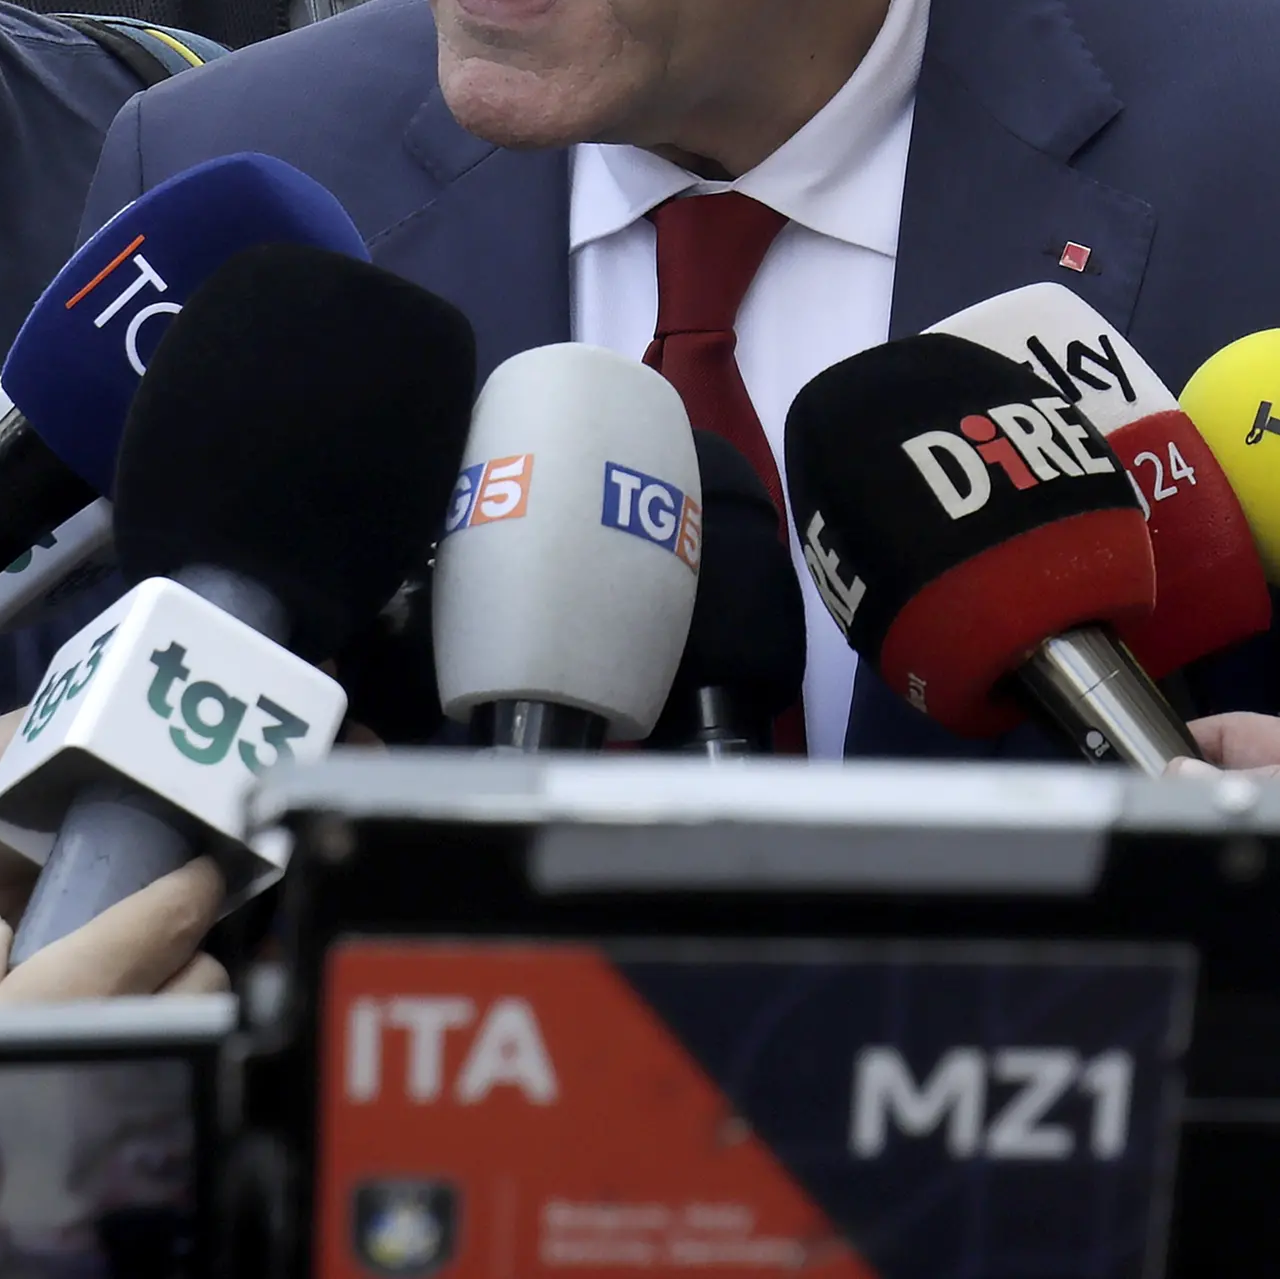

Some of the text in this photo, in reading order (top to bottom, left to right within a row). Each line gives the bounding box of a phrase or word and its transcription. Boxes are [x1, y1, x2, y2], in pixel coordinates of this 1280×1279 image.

[610, 468, 702, 566] TG5
[146, 640, 310, 777] tg3
[345, 993, 561, 1107] ITA
[848, 1043, 1135, 1161] MZ1
